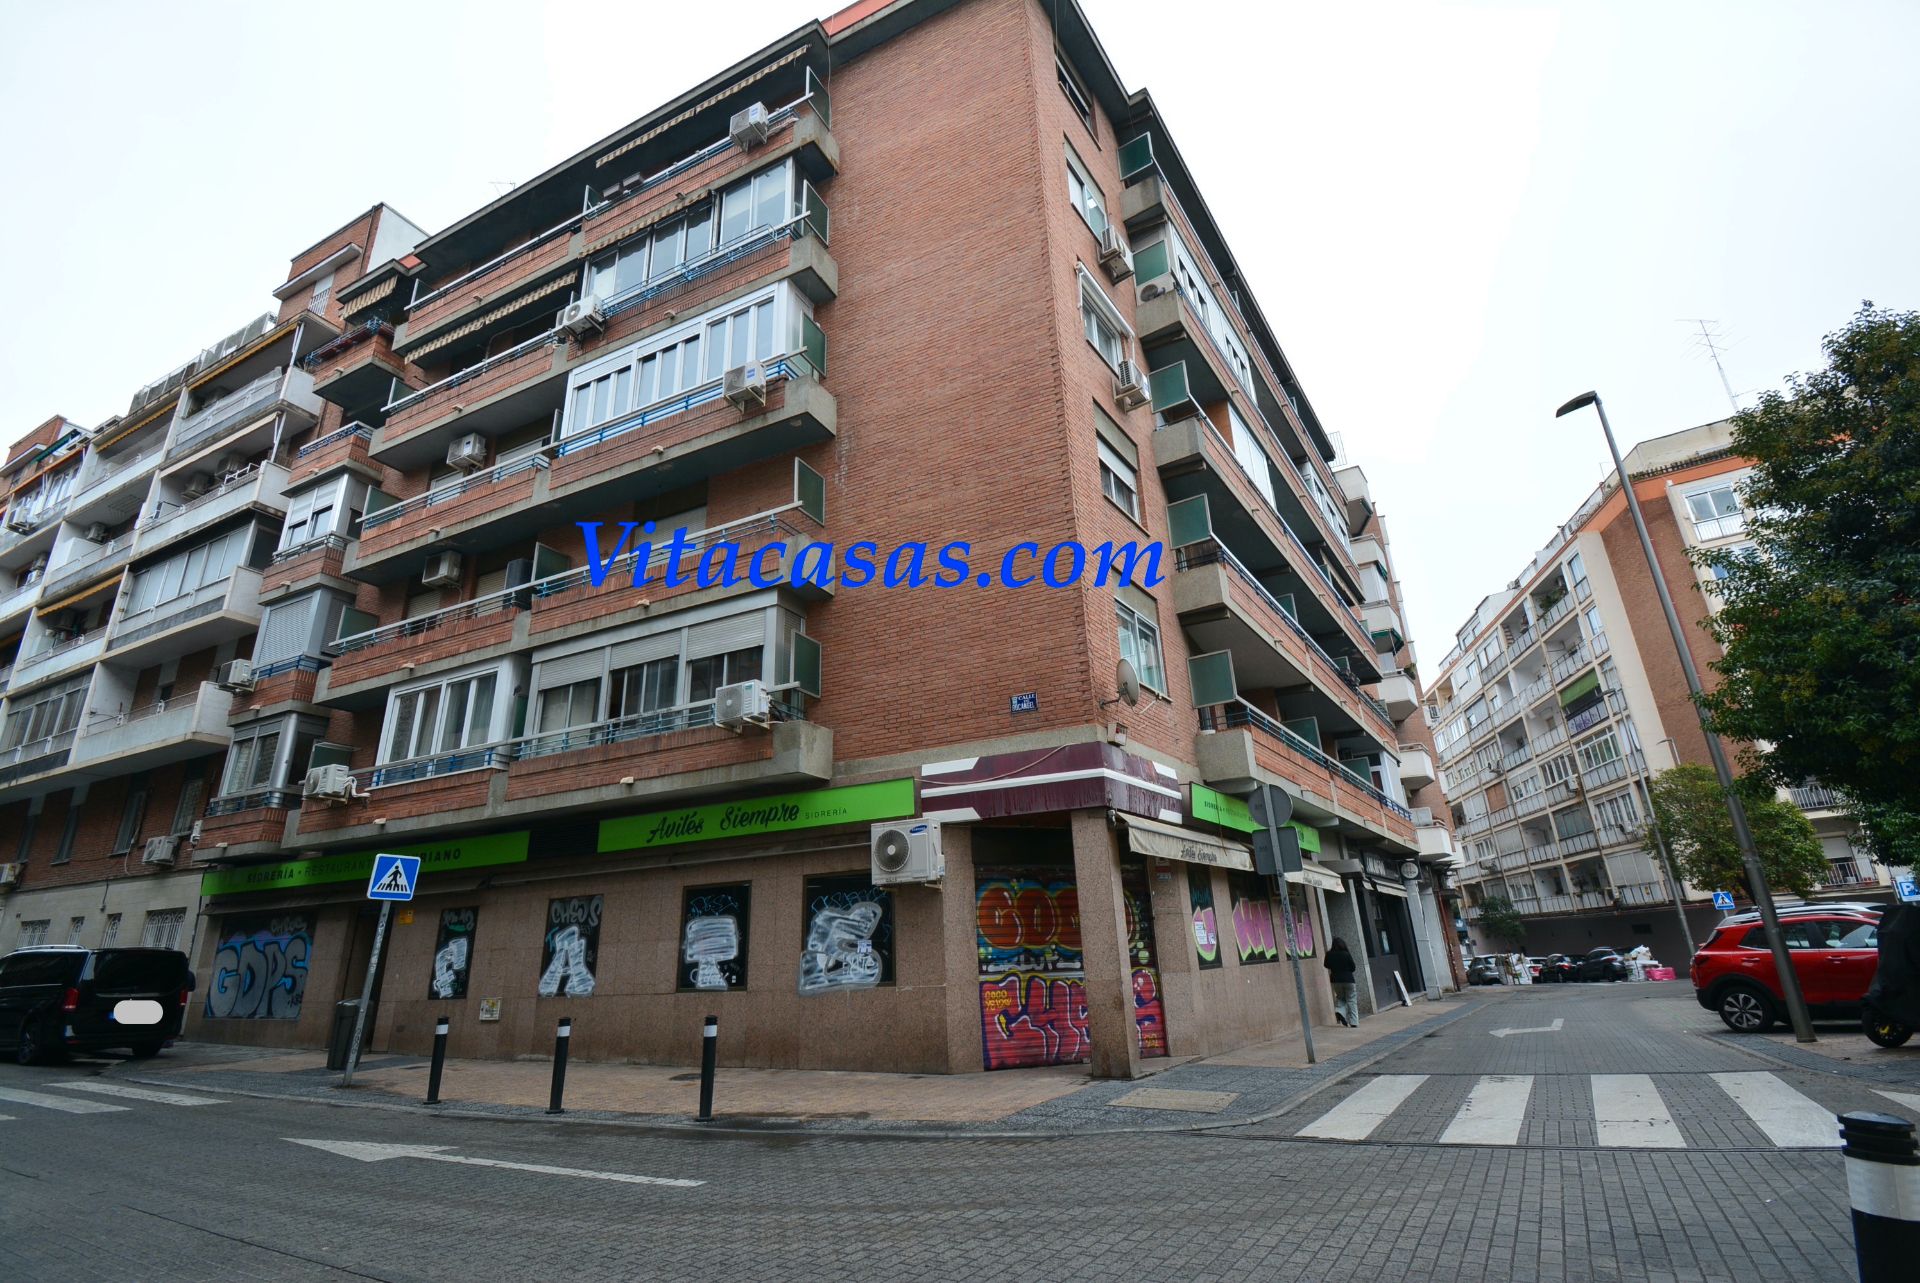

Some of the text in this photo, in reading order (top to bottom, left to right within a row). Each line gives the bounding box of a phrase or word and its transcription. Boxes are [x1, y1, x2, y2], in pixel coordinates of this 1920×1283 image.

[646, 802, 848, 843] Avilés Siempre SIDRERÍA
[246, 866, 295, 884] SIDRERÍA
[304, 859, 375, 876] RESTAURANT
